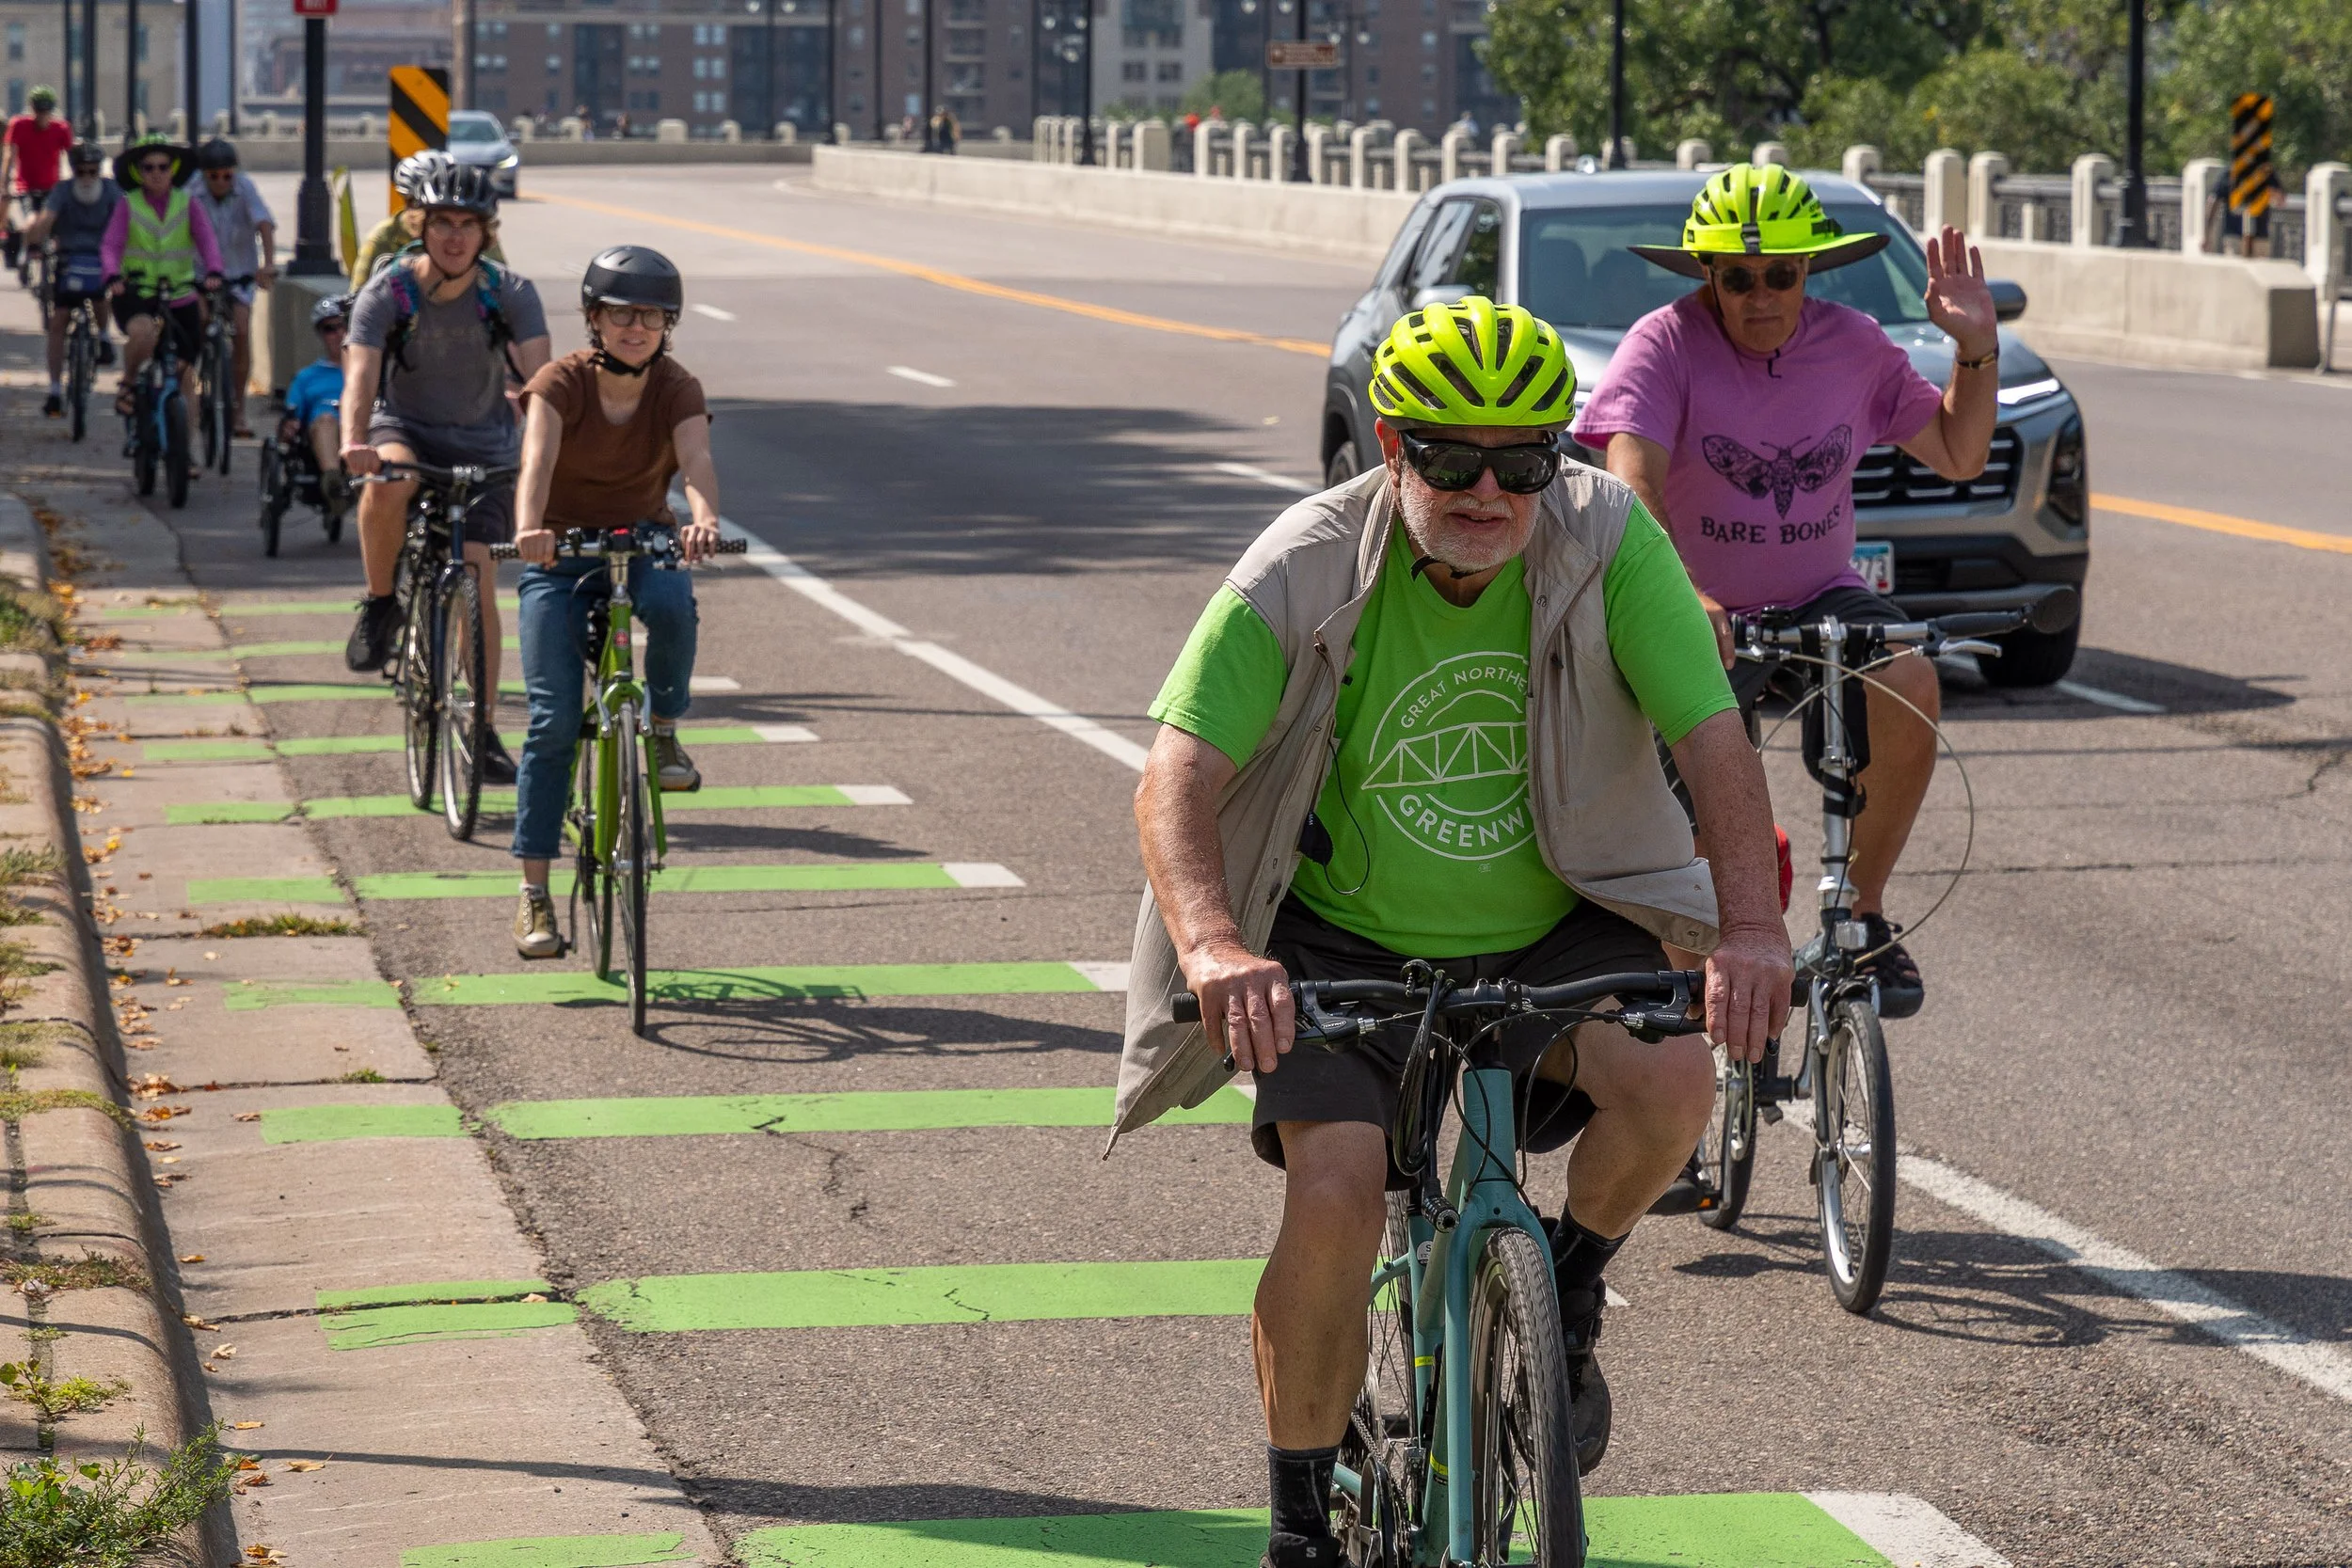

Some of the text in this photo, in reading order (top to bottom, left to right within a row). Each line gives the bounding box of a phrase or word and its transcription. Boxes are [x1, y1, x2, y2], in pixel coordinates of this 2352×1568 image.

[1700, 504, 1840, 545] BARE BONES
[1400, 666, 1528, 728] GREAT NORTHE
